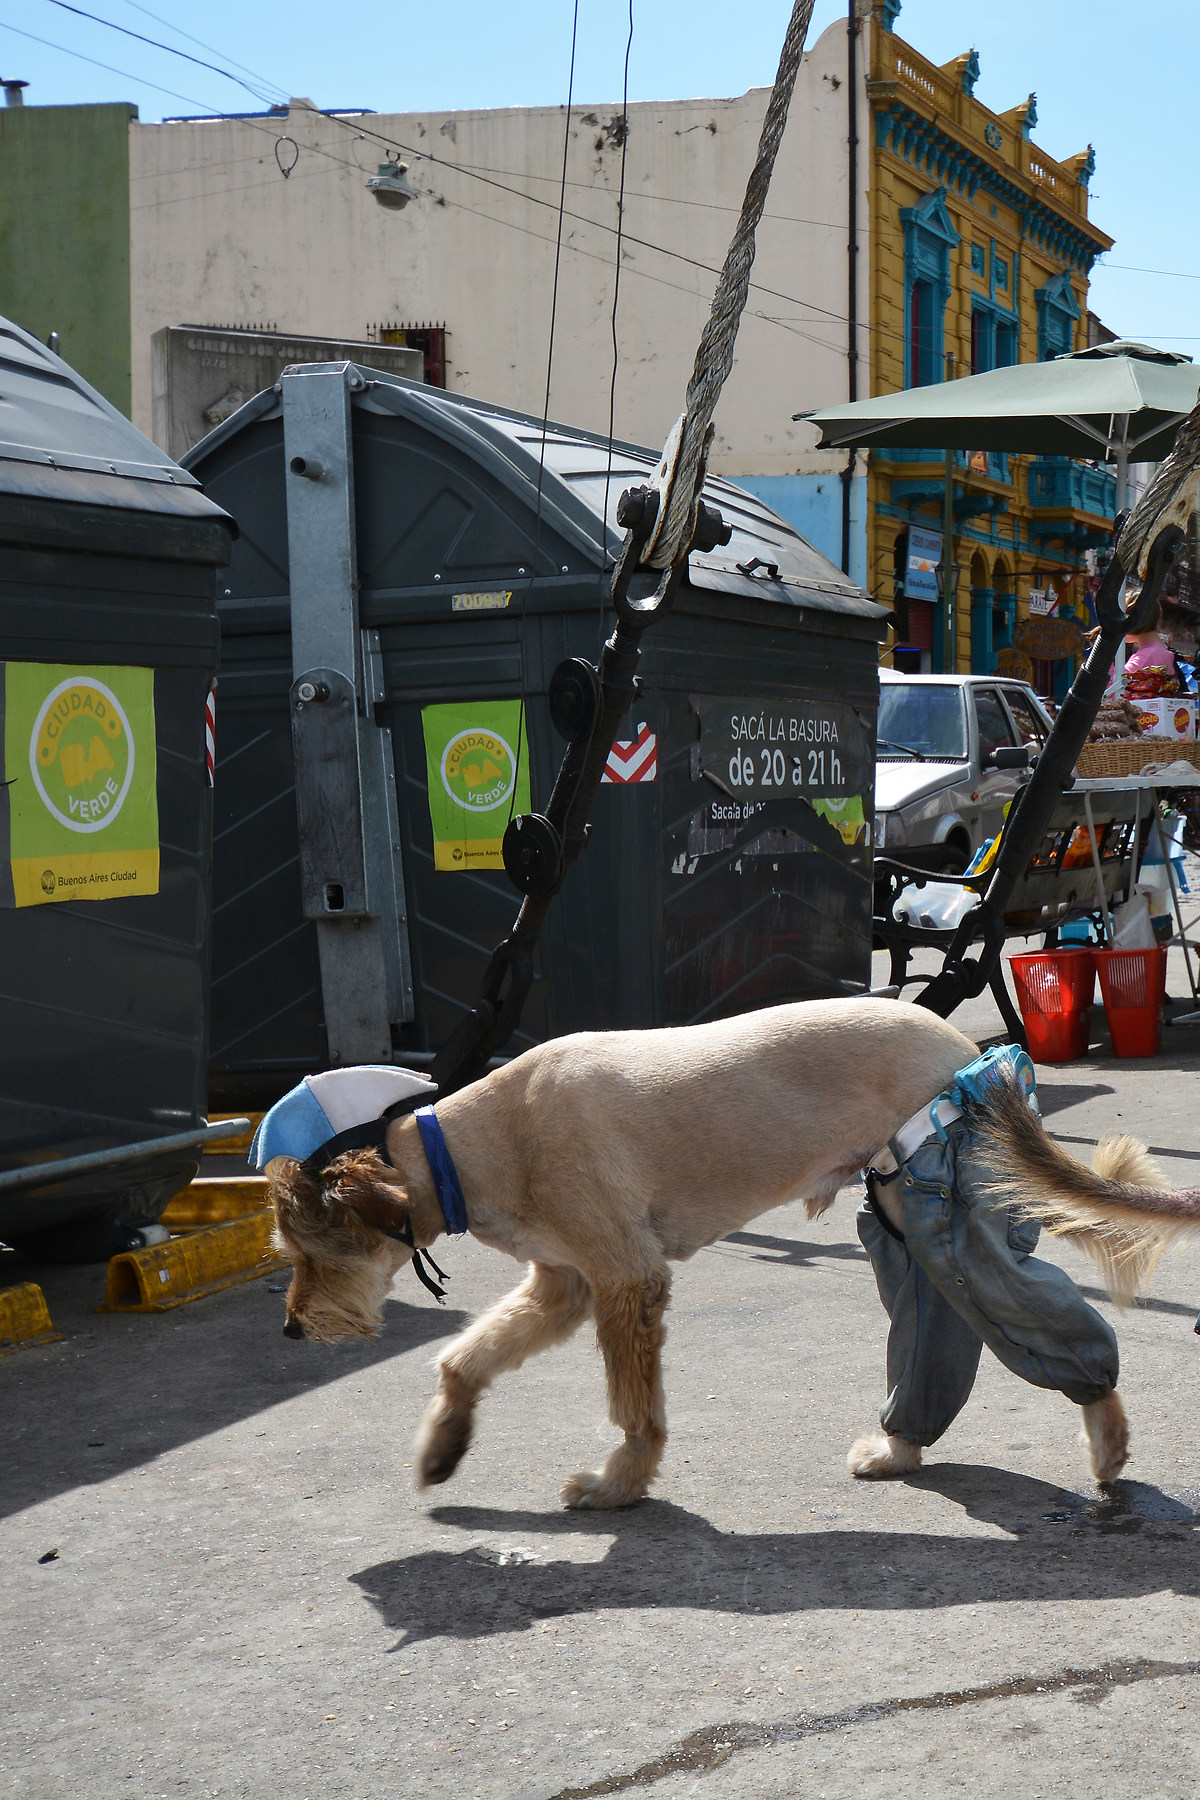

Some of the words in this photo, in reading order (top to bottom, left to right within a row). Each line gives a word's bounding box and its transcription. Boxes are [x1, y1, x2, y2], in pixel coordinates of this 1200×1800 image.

[46, 693, 107, 739] CIUDAD
[731, 711, 766, 741] SACÁ
[769, 717, 786, 741] LA
[789, 718, 839, 743] BASURA
[451, 737, 495, 763] CIUDAD
[729, 747, 755, 786] de
[760, 748, 786, 786] 20
[792, 756, 802, 786] a
[808, 750, 825, 785] 21
[831, 749, 845, 785] h.
[68, 777, 119, 818] VERDE
[468, 781, 507, 804] VERDE
[58, 876, 87, 886] Buenos
[89, 873, 109, 883] Aires
[110, 870, 137, 881] Ciudad
